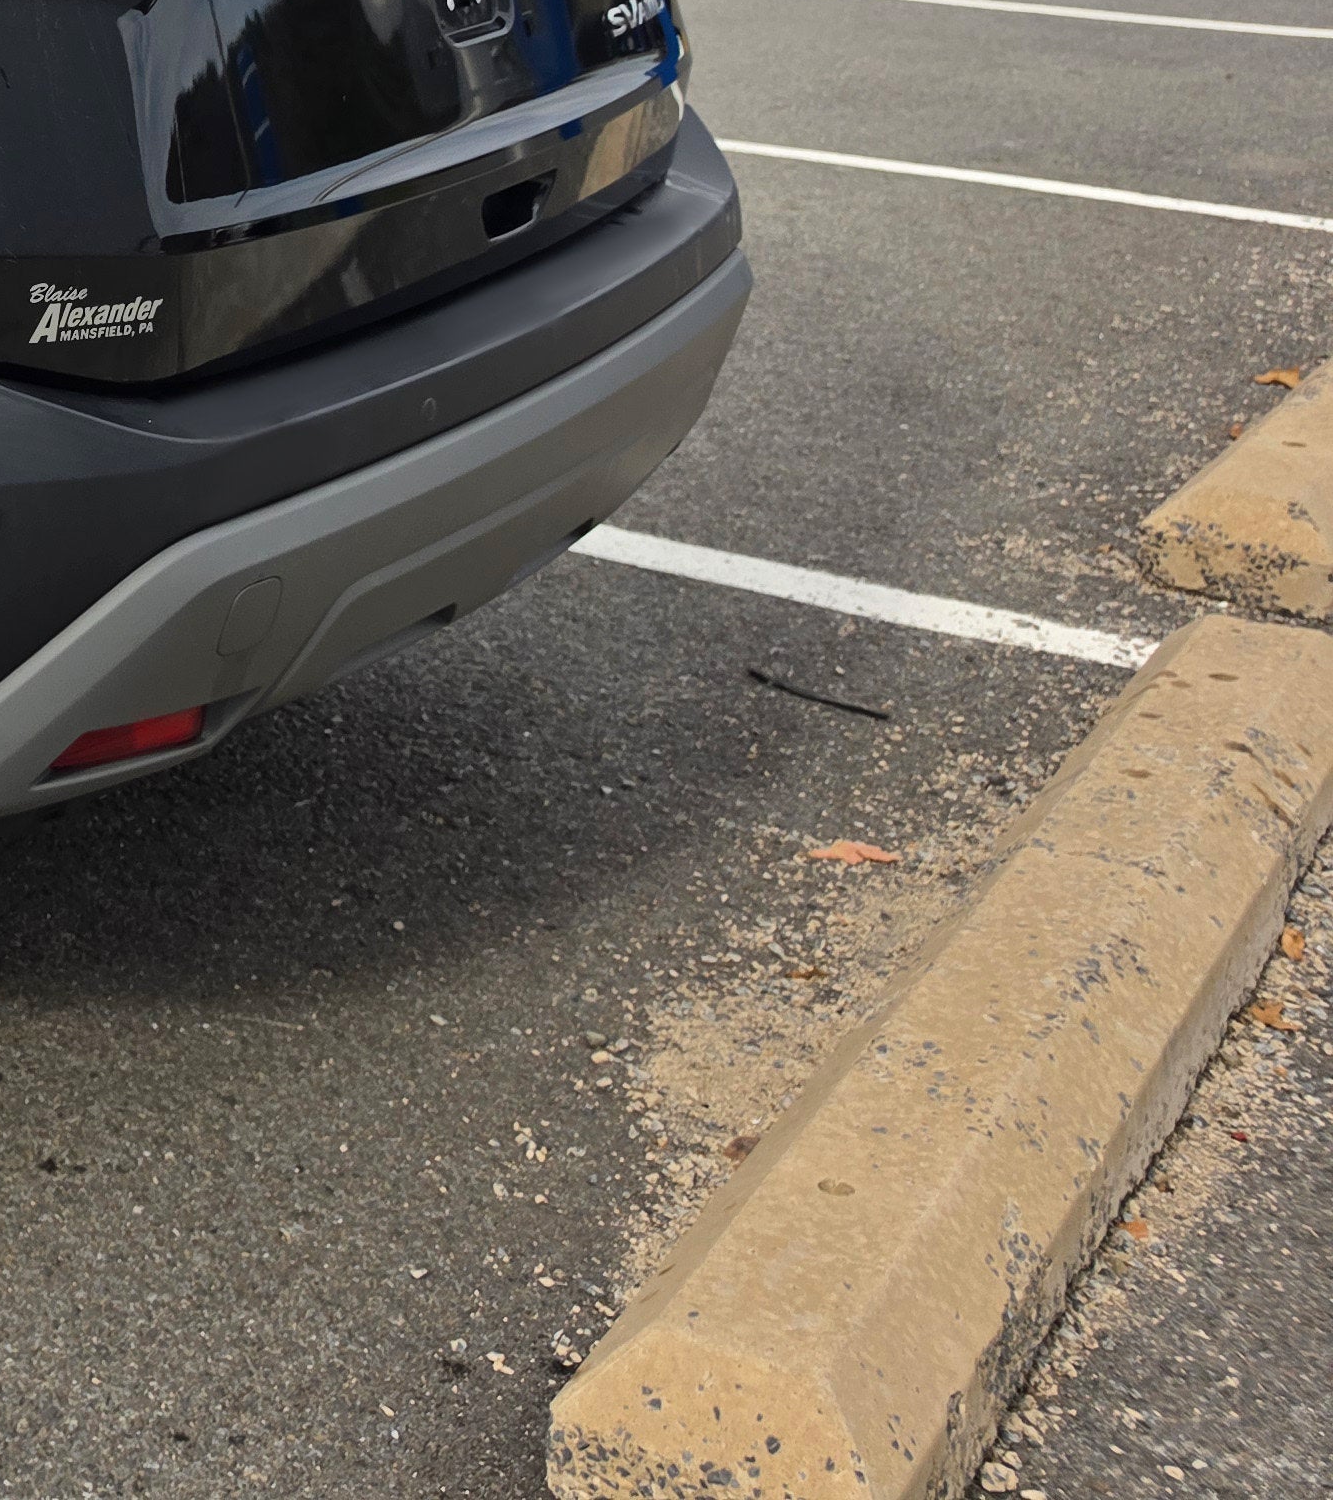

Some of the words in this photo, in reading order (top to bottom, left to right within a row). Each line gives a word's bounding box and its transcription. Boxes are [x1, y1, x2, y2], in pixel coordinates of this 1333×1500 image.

[29, 282, 88, 304] Blaise
[28, 296, 164, 344] Alexander
[59, 325, 136, 342] MANSFIELD,
[138, 322, 154, 334] PA
